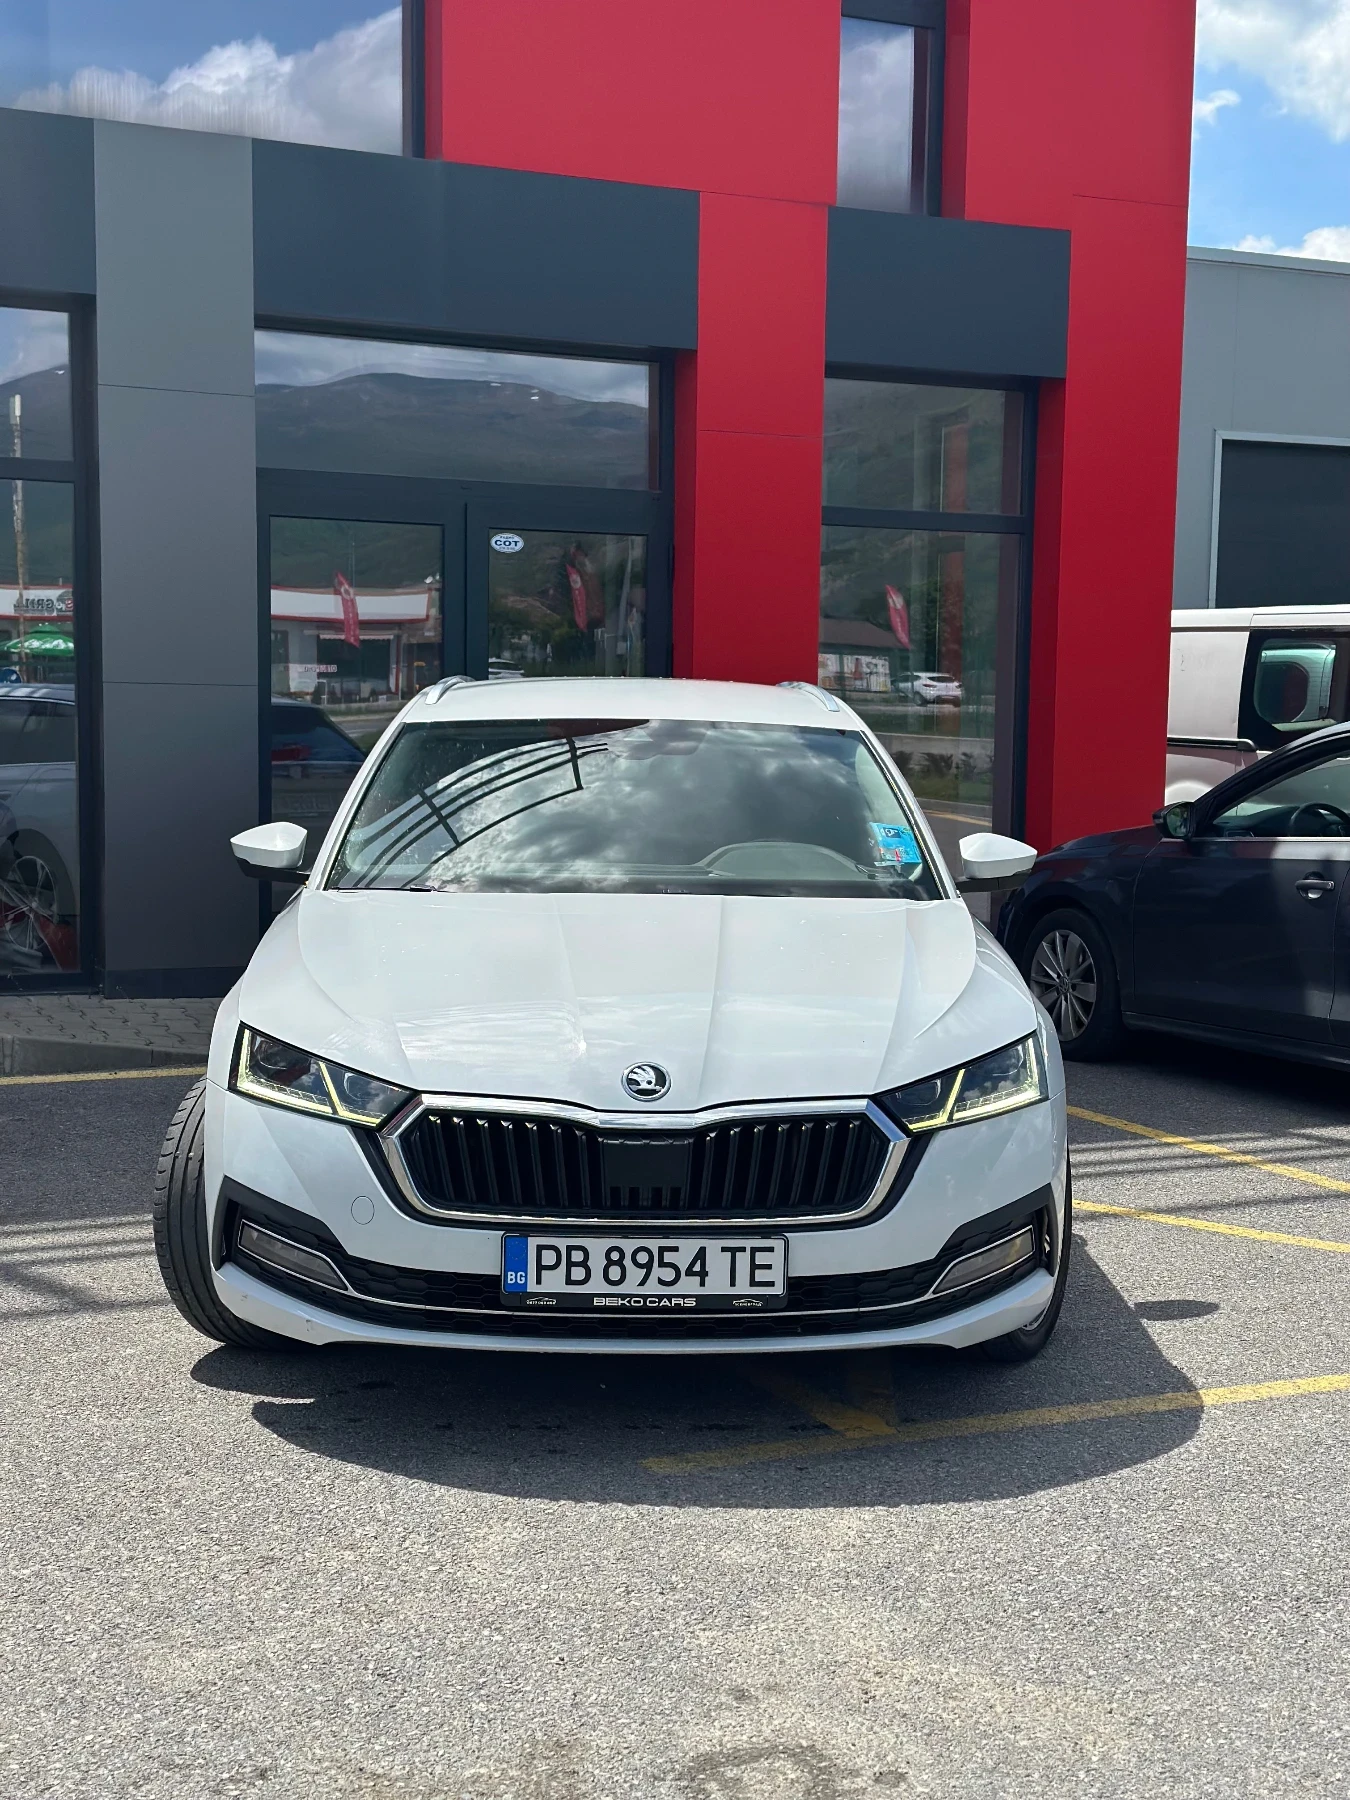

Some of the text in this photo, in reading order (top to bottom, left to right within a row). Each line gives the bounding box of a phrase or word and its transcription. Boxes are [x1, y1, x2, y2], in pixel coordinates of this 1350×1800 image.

[535, 1244, 776, 1288] PB 8954 TE
[507, 1271, 526, 1284] BG
[593, 1297, 697, 1307] BEKO CARS
